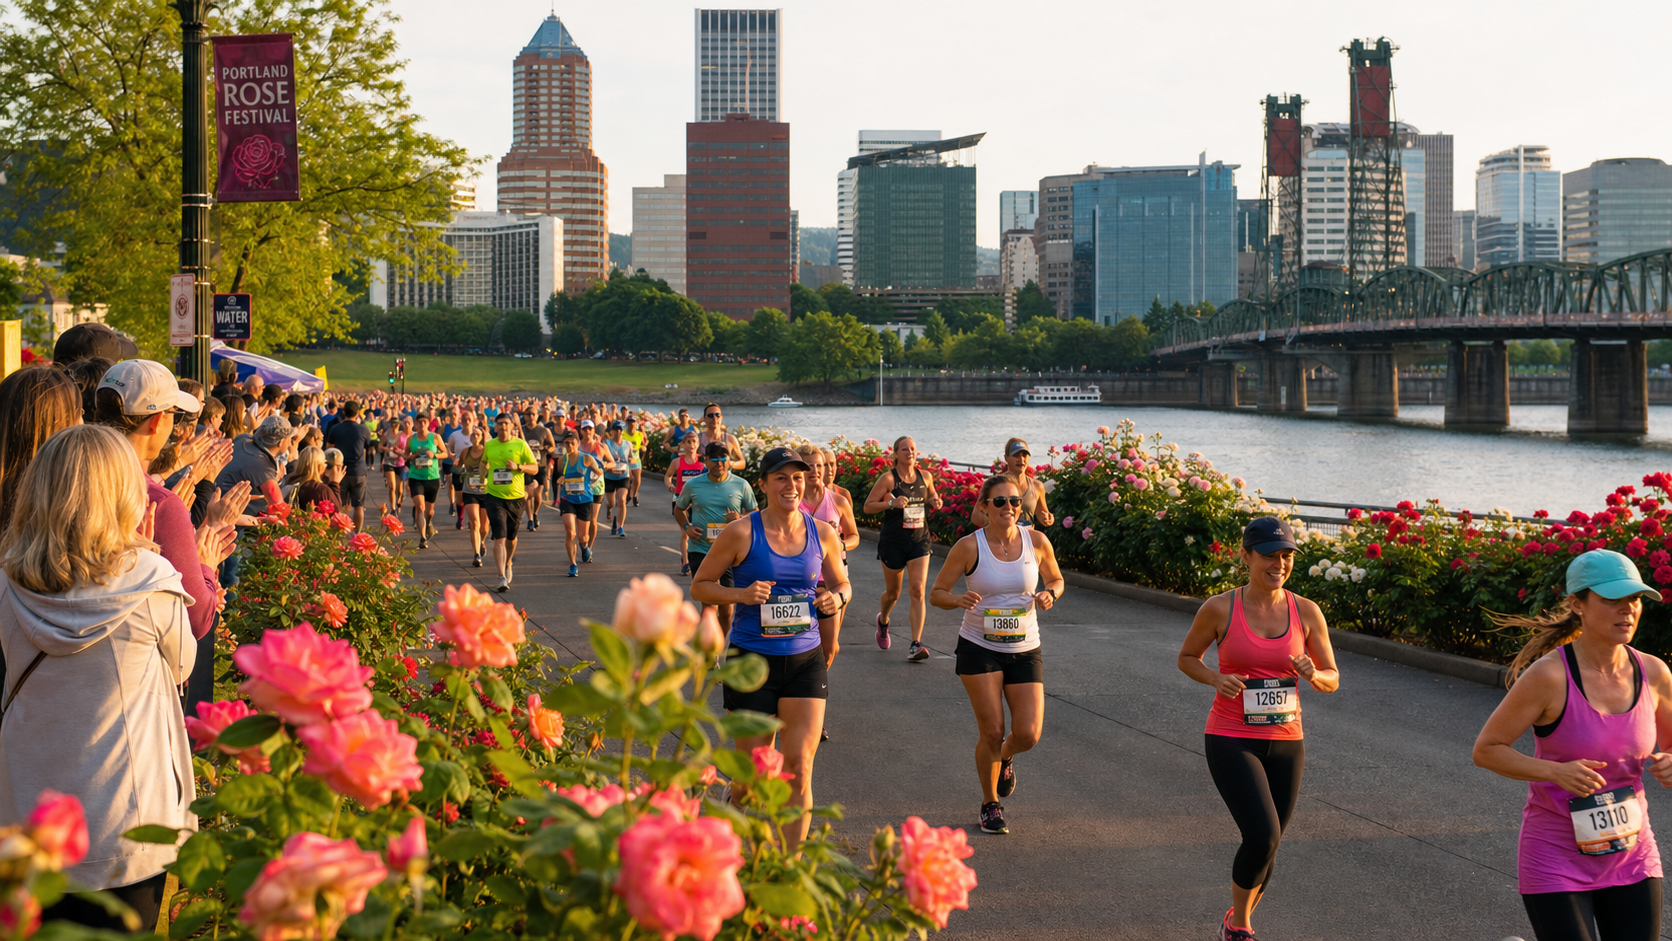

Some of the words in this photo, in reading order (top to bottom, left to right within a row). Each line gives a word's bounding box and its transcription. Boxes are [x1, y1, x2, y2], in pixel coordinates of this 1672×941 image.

[222, 64, 288, 80] PORTLAND
[223, 81, 290, 107] ROSE
[225, 108, 291, 125] FESTIVAL
[216, 310, 248, 324] WATER
[771, 605, 801, 619] 16622
[993, 618, 1019, 629] 13860
[1255, 690, 1288, 706] 12657
[1589, 805, 1629, 831] 13110
